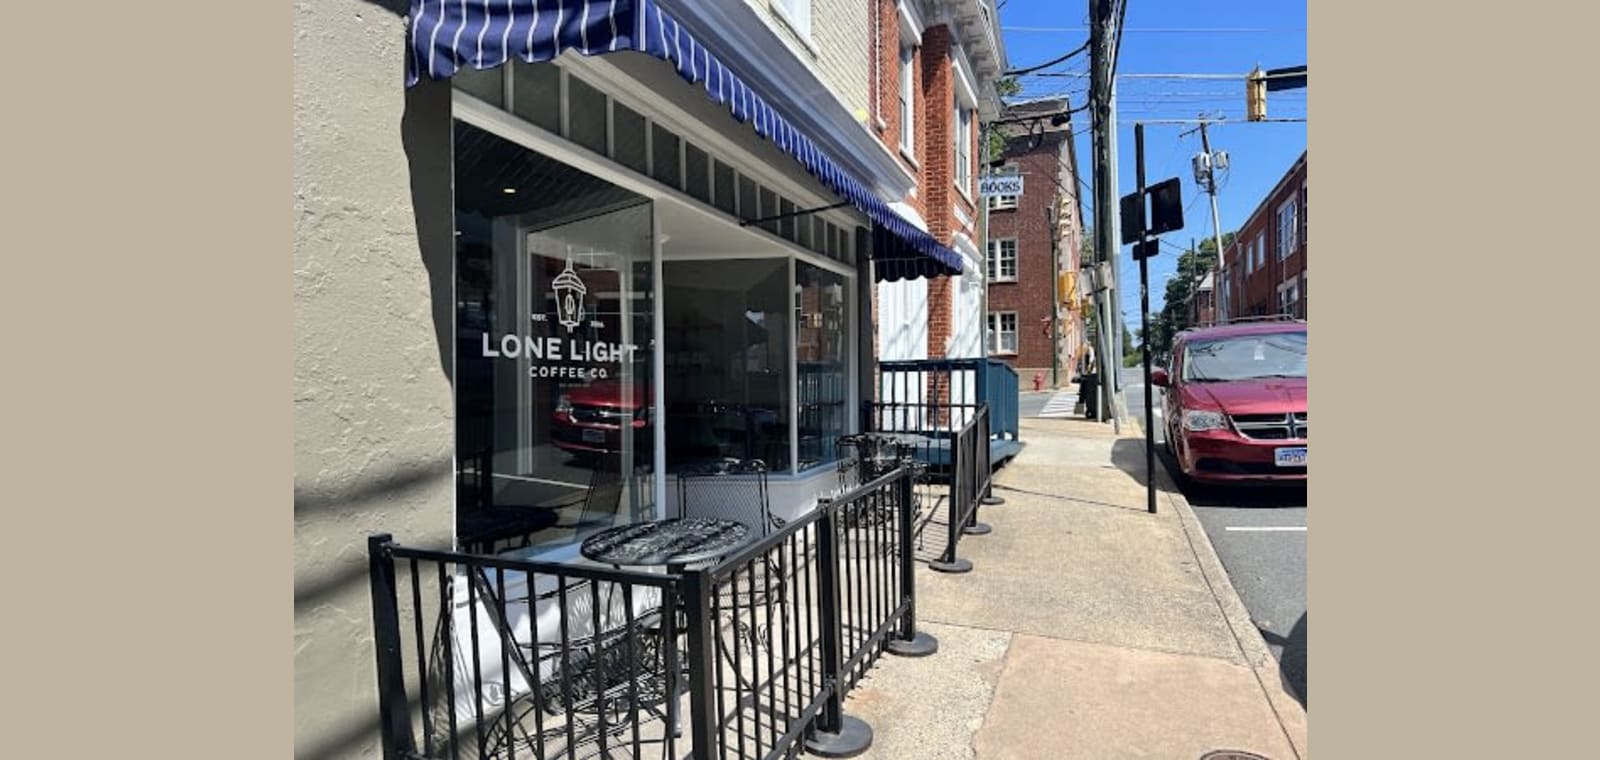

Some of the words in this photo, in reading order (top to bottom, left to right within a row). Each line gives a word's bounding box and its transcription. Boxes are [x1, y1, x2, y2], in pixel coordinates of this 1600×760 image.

[980, 181, 1020, 193] BOOKS
[482, 332, 562, 360] LONE
[570, 339, 638, 363] LIGHT
[529, 366, 585, 378] COFFEE
